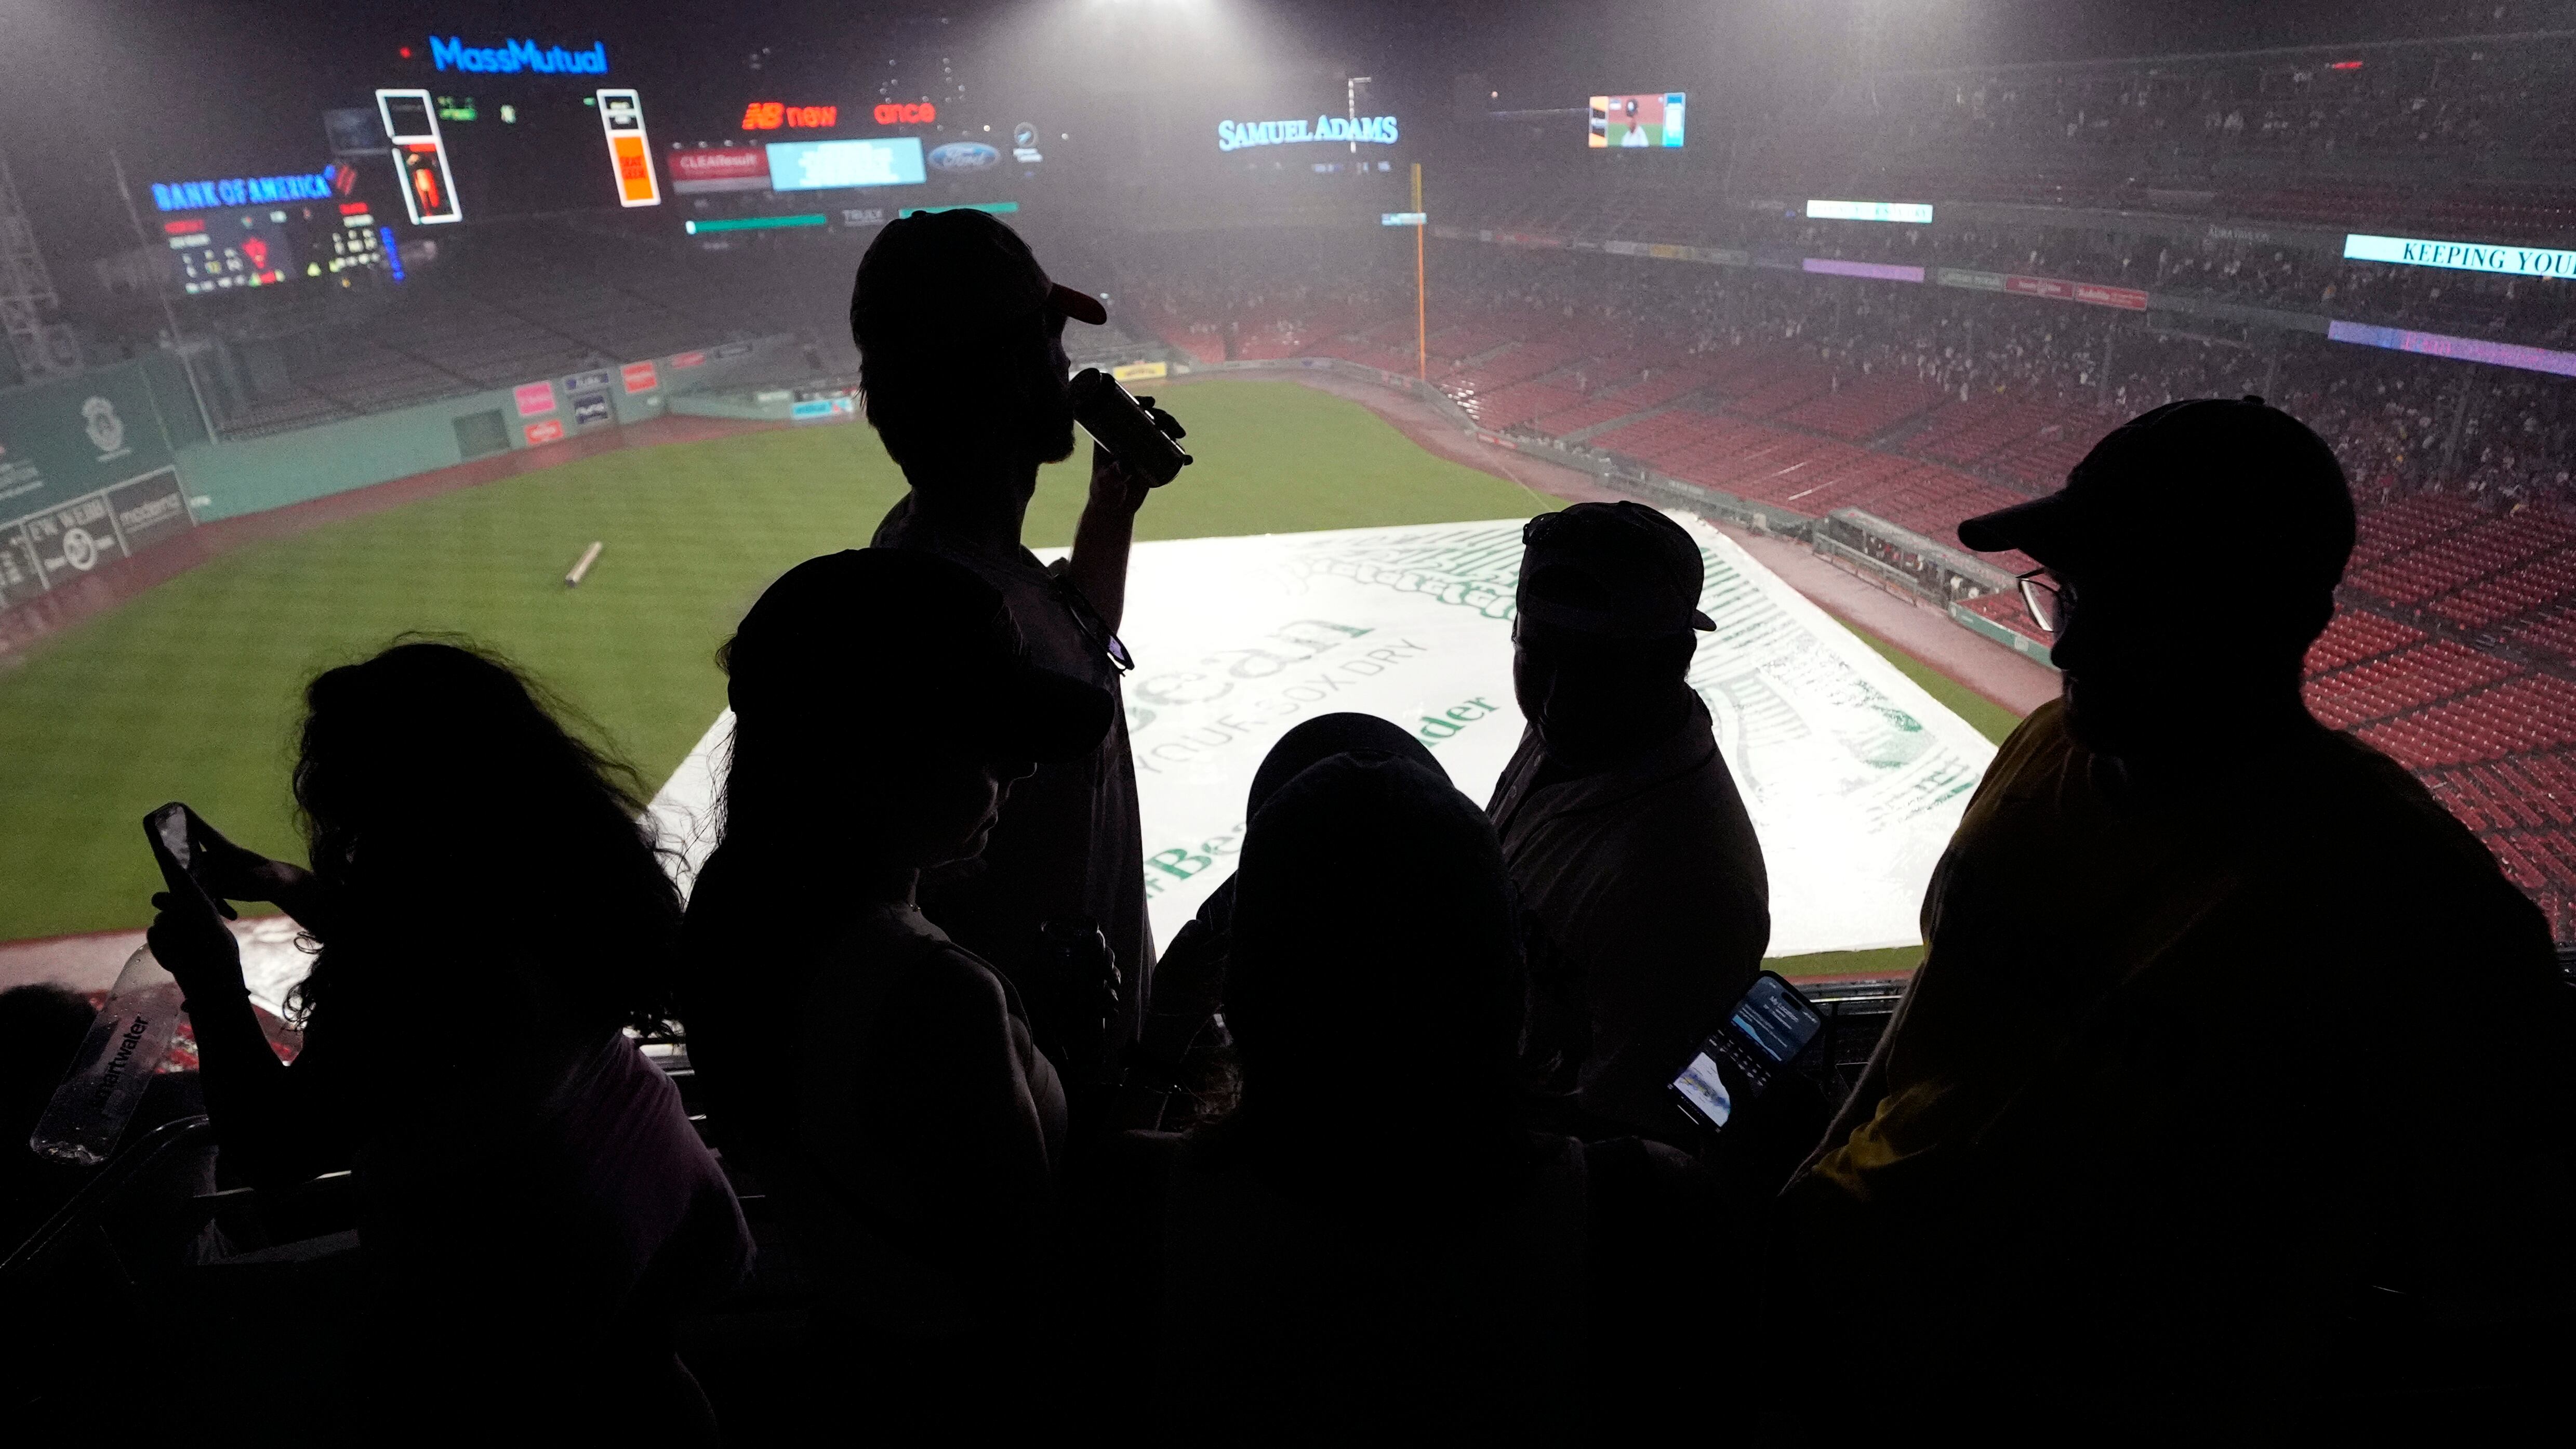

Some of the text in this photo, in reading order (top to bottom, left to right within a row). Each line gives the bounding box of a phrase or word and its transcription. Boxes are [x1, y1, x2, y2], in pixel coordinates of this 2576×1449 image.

[429, 35, 608, 75] MassMutual
[1218, 115, 1399, 151] SAMUEL ADAMS
[151, 174, 333, 211] BANK OF AMERICA
[2403, 242, 2576, 275] KEEPING YOU
[1126, 620, 1375, 734] ean
[1254, 674, 1362, 716] SOX
[1339, 638, 1428, 677] DRY
